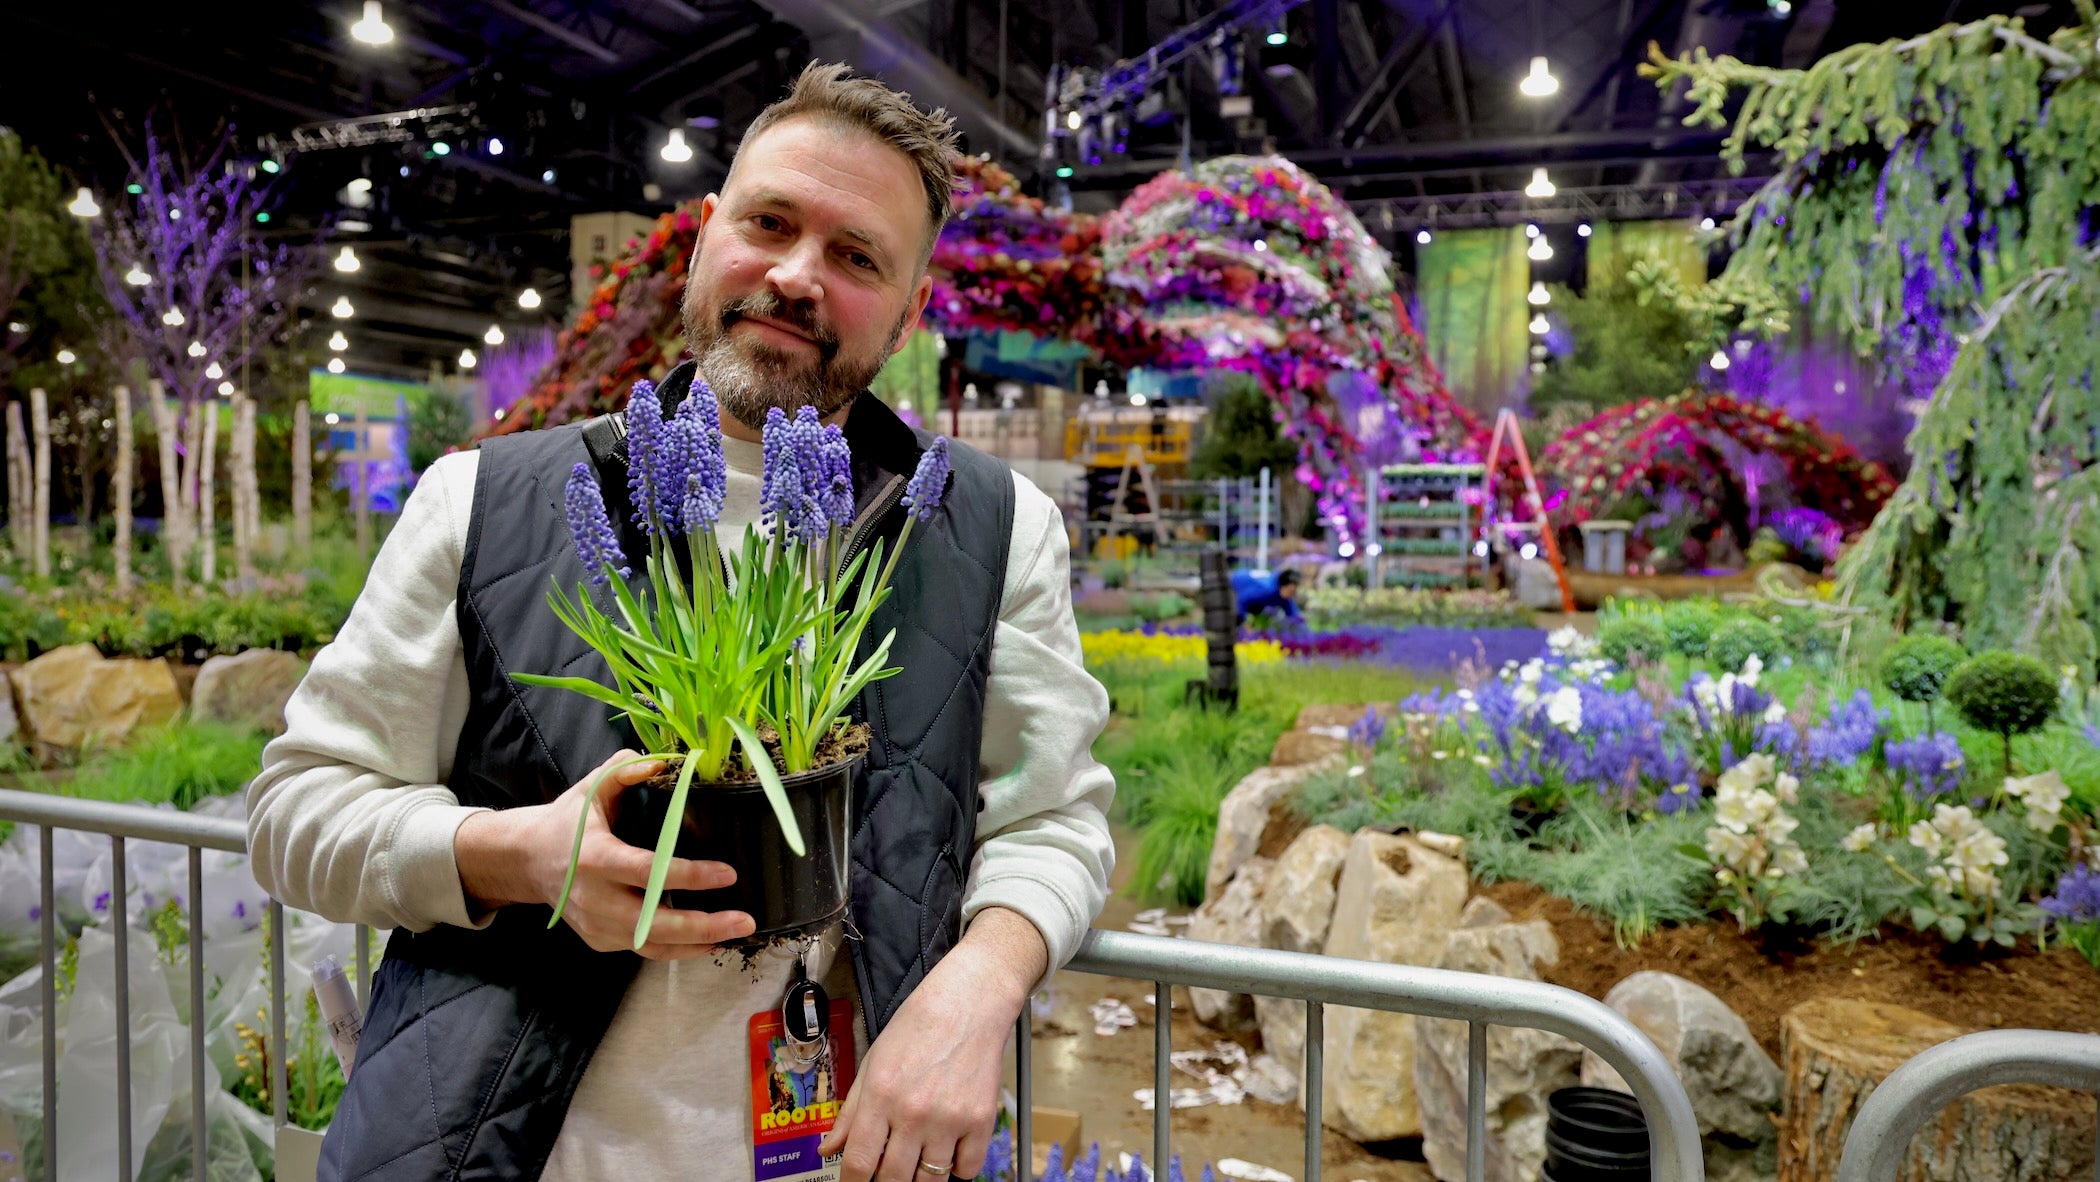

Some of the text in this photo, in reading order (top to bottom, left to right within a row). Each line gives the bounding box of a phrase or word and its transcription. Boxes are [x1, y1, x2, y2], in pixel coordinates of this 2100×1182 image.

[762, 1128, 784, 1136] ORIGINS
[789, 1121, 817, 1131] AMERICAN
[763, 1152, 800, 1165] PHS STAFF
